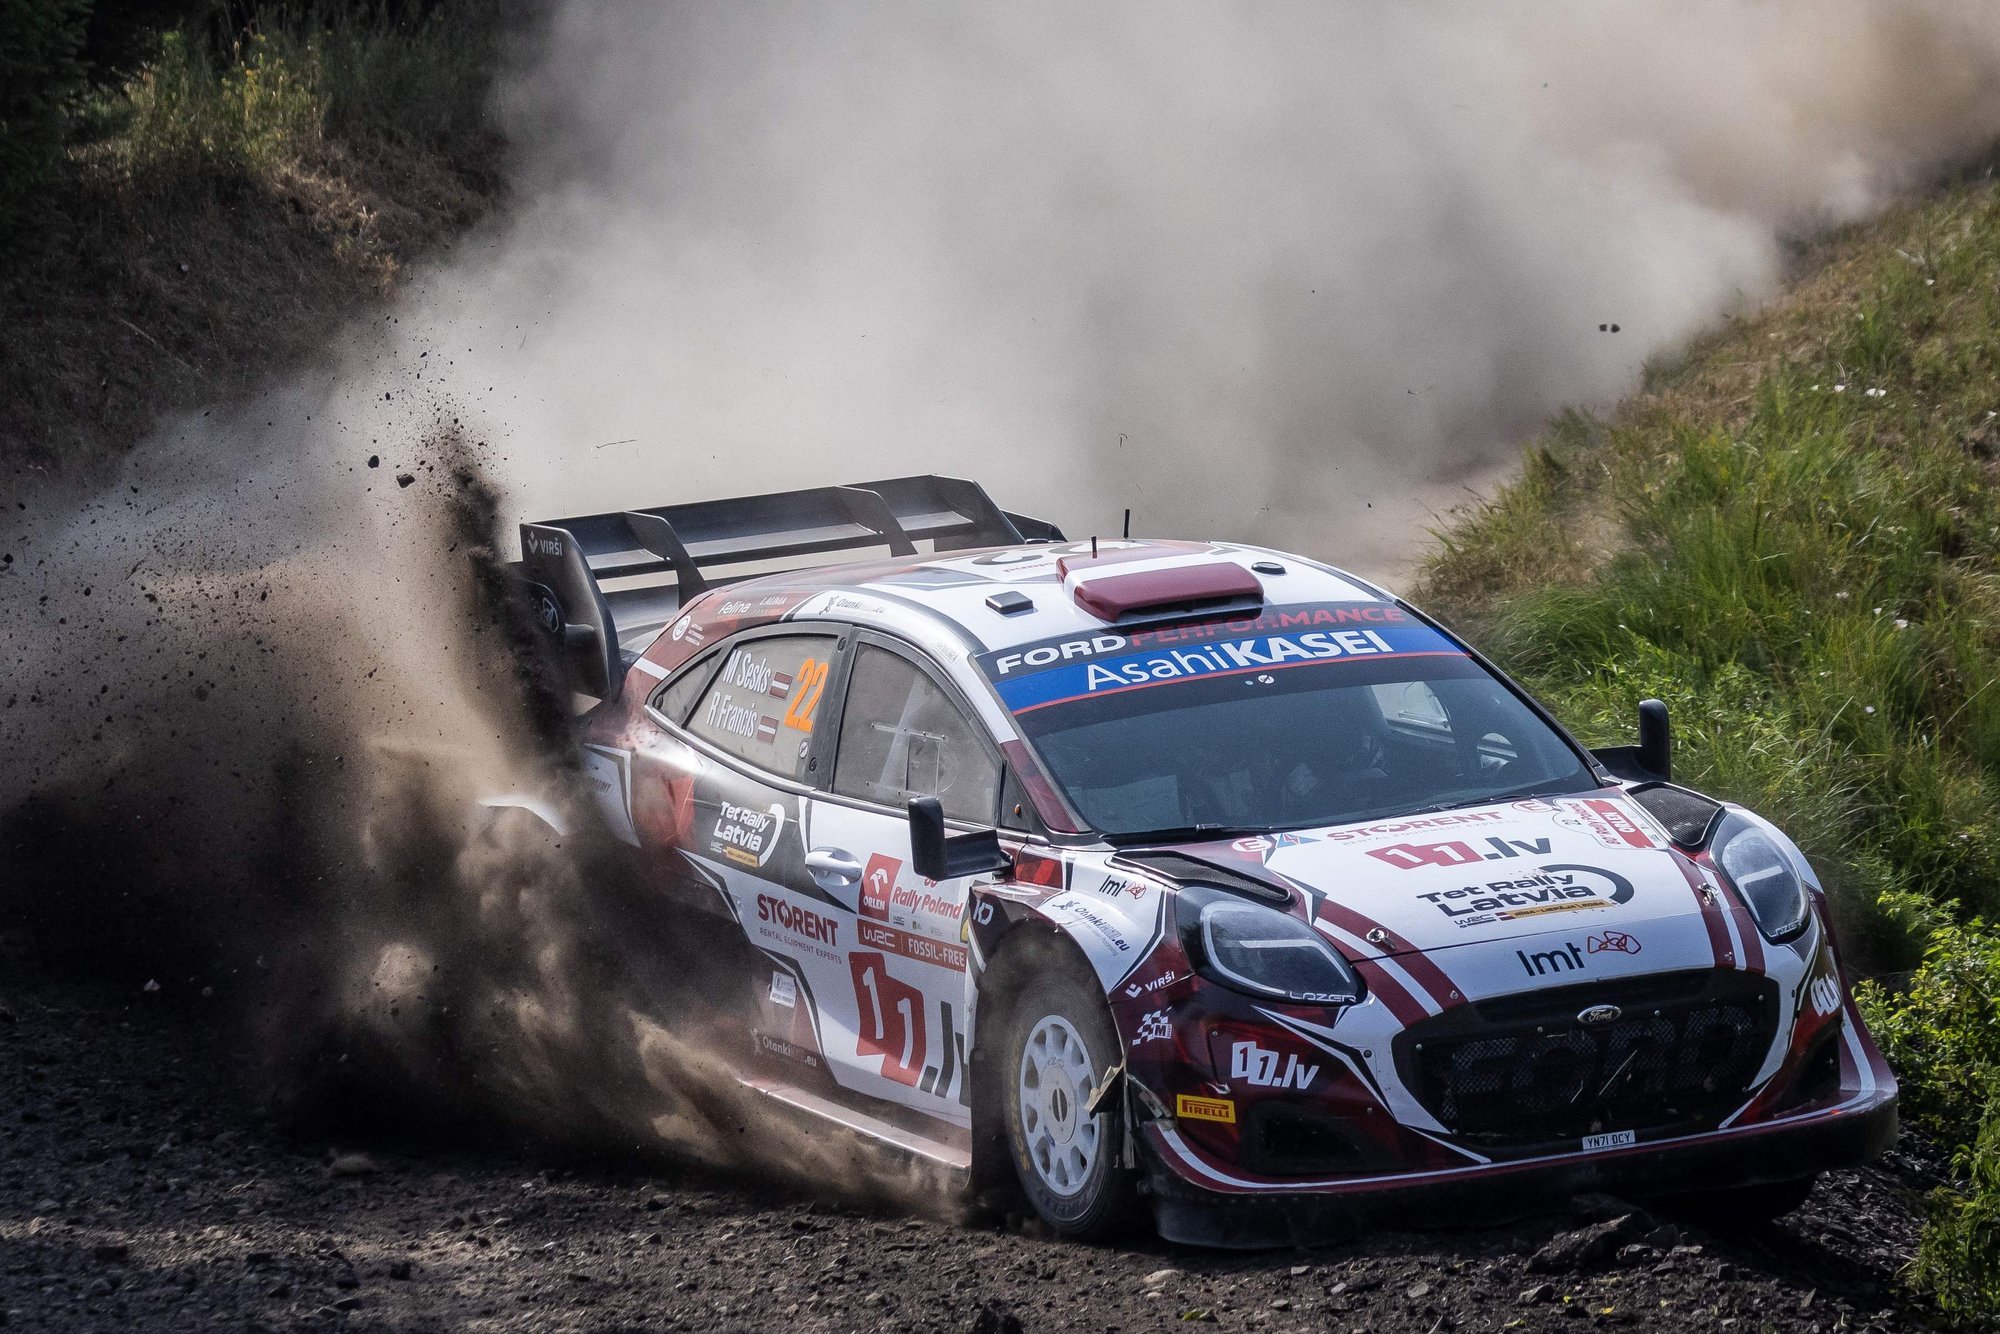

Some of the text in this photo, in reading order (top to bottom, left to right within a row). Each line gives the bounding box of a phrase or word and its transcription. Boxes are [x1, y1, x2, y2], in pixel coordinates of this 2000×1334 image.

[540, 538, 563, 556] VIRŠI
[718, 600, 752, 614] felina
[996, 635, 1127, 675] FORD
[1131, 607, 1406, 648] PERFORMANCE
[723, 649, 772, 694] M Sesks
[783, 658, 829, 733] 22
[706, 691, 758, 738] R Francis
[720, 801, 770, 832] Tet Rally
[1327, 811, 1503, 841] STORENT
[713, 818, 763, 851] Latvia
[1364, 836, 1552, 870] 11.lv
[1099, 875, 1127, 897] lmt
[1416, 874, 1574, 903] Tet Rally
[1437, 884, 1596, 917] Latvia
[863, 895, 886, 911] ORLEN
[892, 886, 964, 920] Rally Poland
[757, 893, 839, 947] STORENT
[863, 925, 896, 948] WRC
[908, 938, 966, 967] FOSSIL-FREE
[1516, 942, 1585, 977] lmt
[1145, 971, 1175, 992] VIRŠI
[1588, 1008, 1613, 1022] Ford
[1231, 1041, 1320, 1089] 11.lv
[1181, 1099, 1230, 1119] PIRELLI
[1587, 1135, 1609, 1148] YN71
